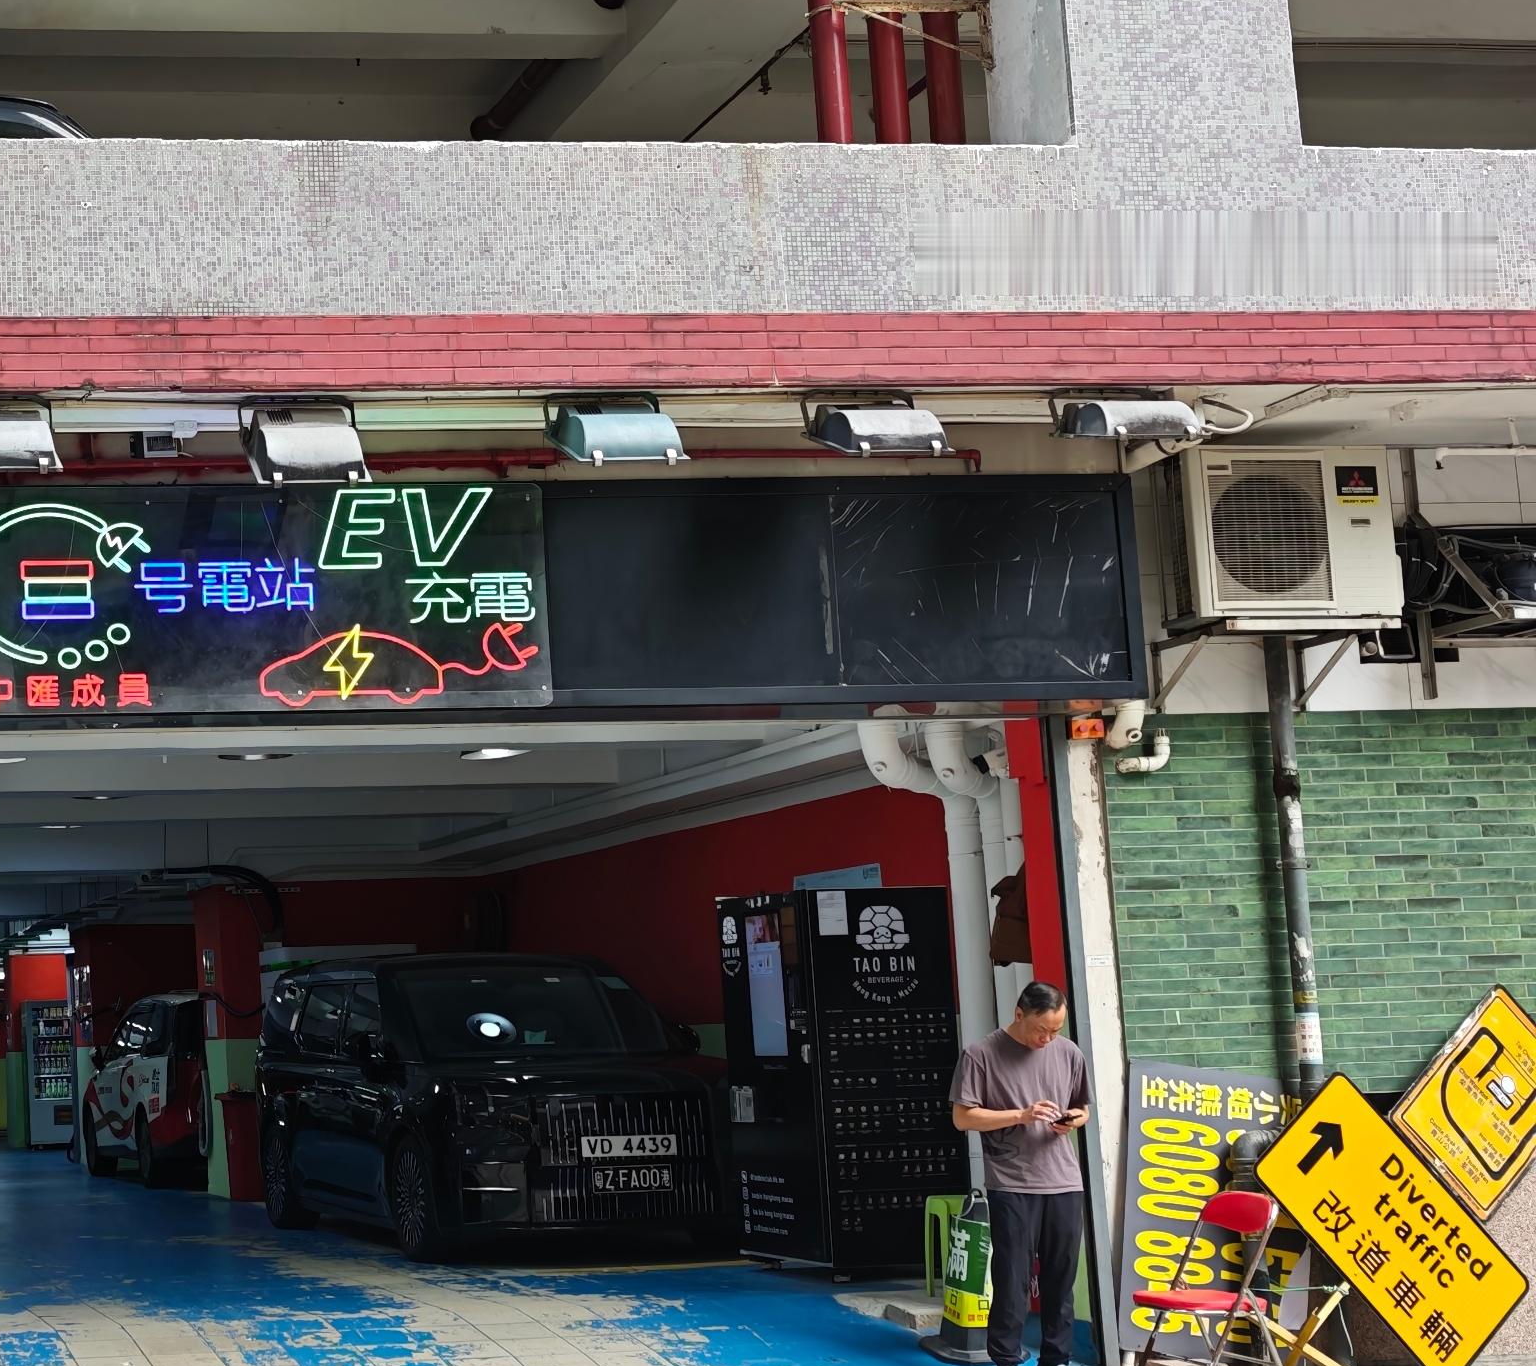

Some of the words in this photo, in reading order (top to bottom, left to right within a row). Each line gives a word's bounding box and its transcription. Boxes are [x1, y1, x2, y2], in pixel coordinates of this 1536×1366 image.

[318, 488, 492, 569] EV
[405, 571, 536, 624] 充電
[852, 980, 868, 1000] Hong
[872, 994, 891, 1004] Kong
[898, 978, 919, 999] Macau
[853, 957, 881, 973] TAO
[890, 956, 916, 972] BIN
[867, 976, 904, 984] BEVERAGE
[1141, 1074, 1221, 1117] 熊先生
[586, 1138, 612, 1155] VD
[623, 1137, 671, 1154] 4439
[1137, 1118, 1221, 1222] 6080
[1428, 1117, 1445, 1135] Castle
[1464, 1155, 1480, 1172] Tsuen
[1477, 1171, 1489, 1184] Wan
[1375, 1192, 1456, 1290] traffic
[1379, 1153, 1493, 1282] Diverted
[1312, 1190, 1463, 1364] 改道車輛
